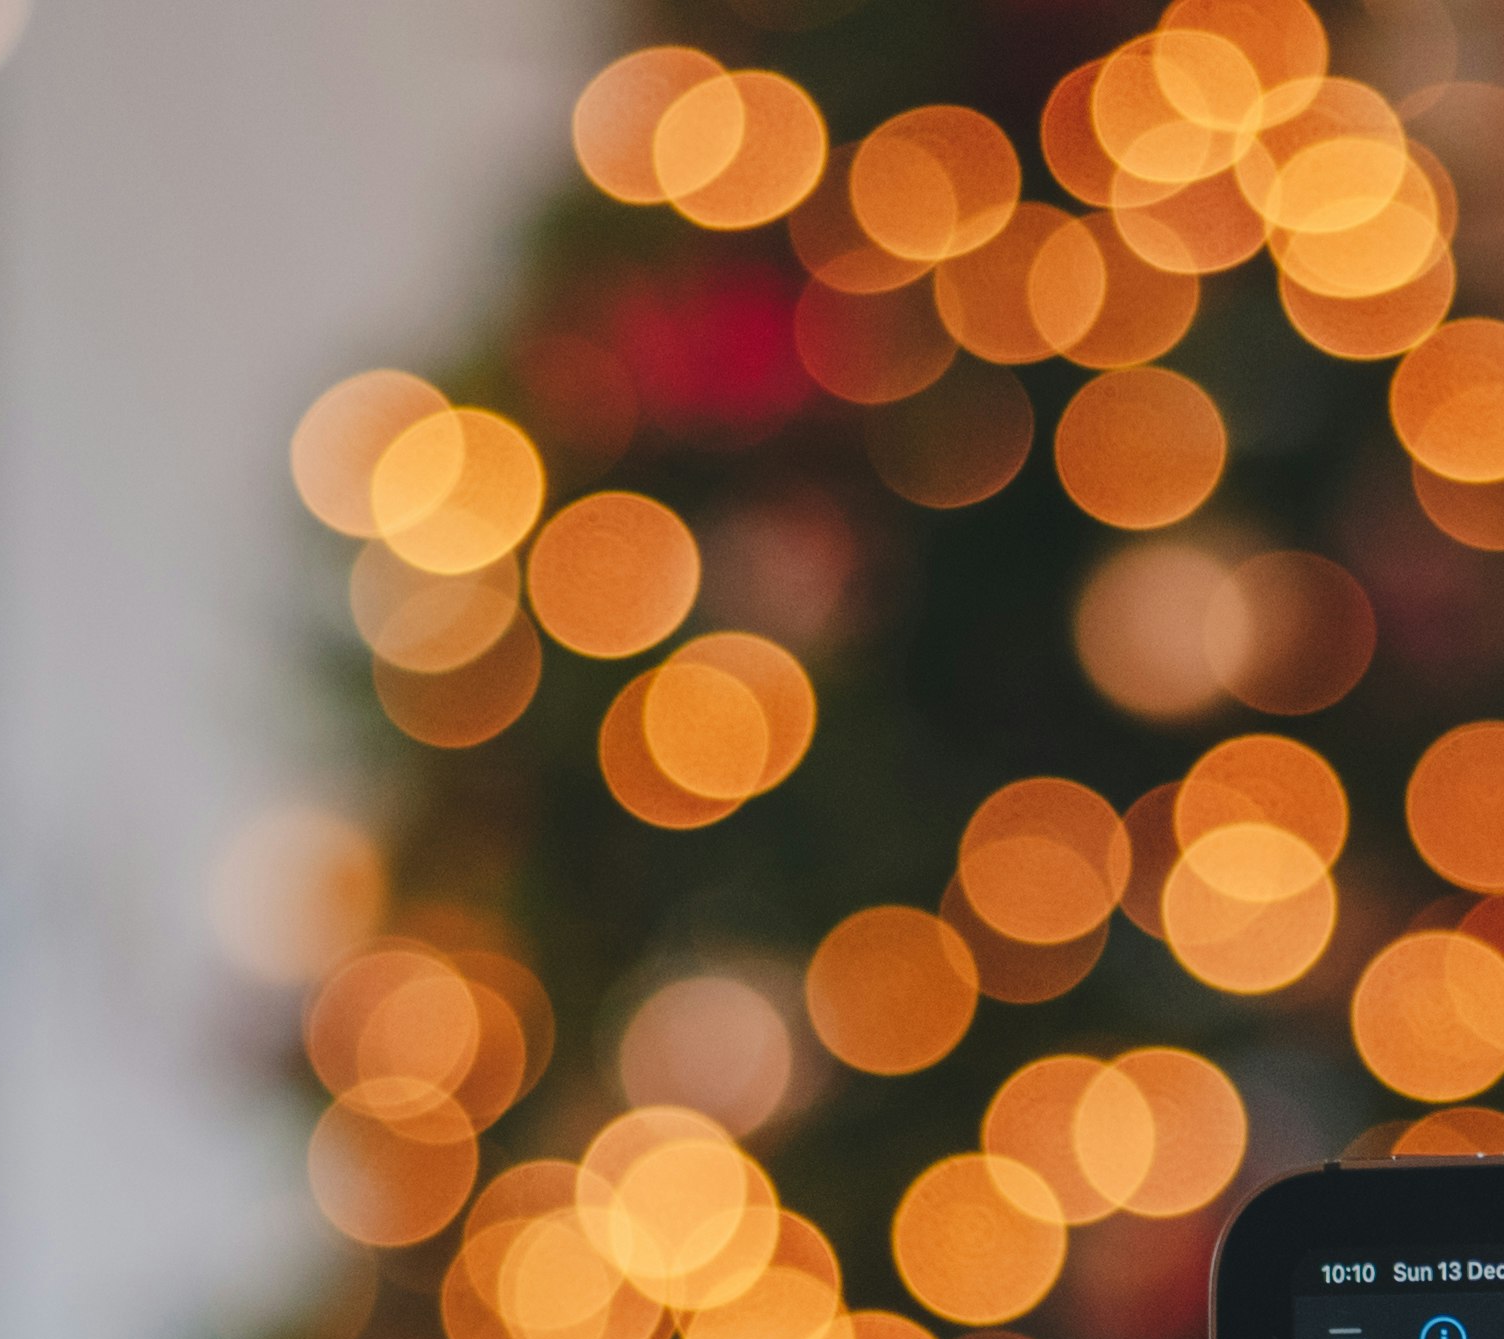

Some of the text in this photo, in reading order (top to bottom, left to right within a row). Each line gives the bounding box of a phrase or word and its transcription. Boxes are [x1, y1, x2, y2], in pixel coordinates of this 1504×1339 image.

[1321, 1263, 1376, 1284] 10:10
[1393, 1262, 1433, 1282] Sun
[1437, 1261, 1462, 1281] 13
